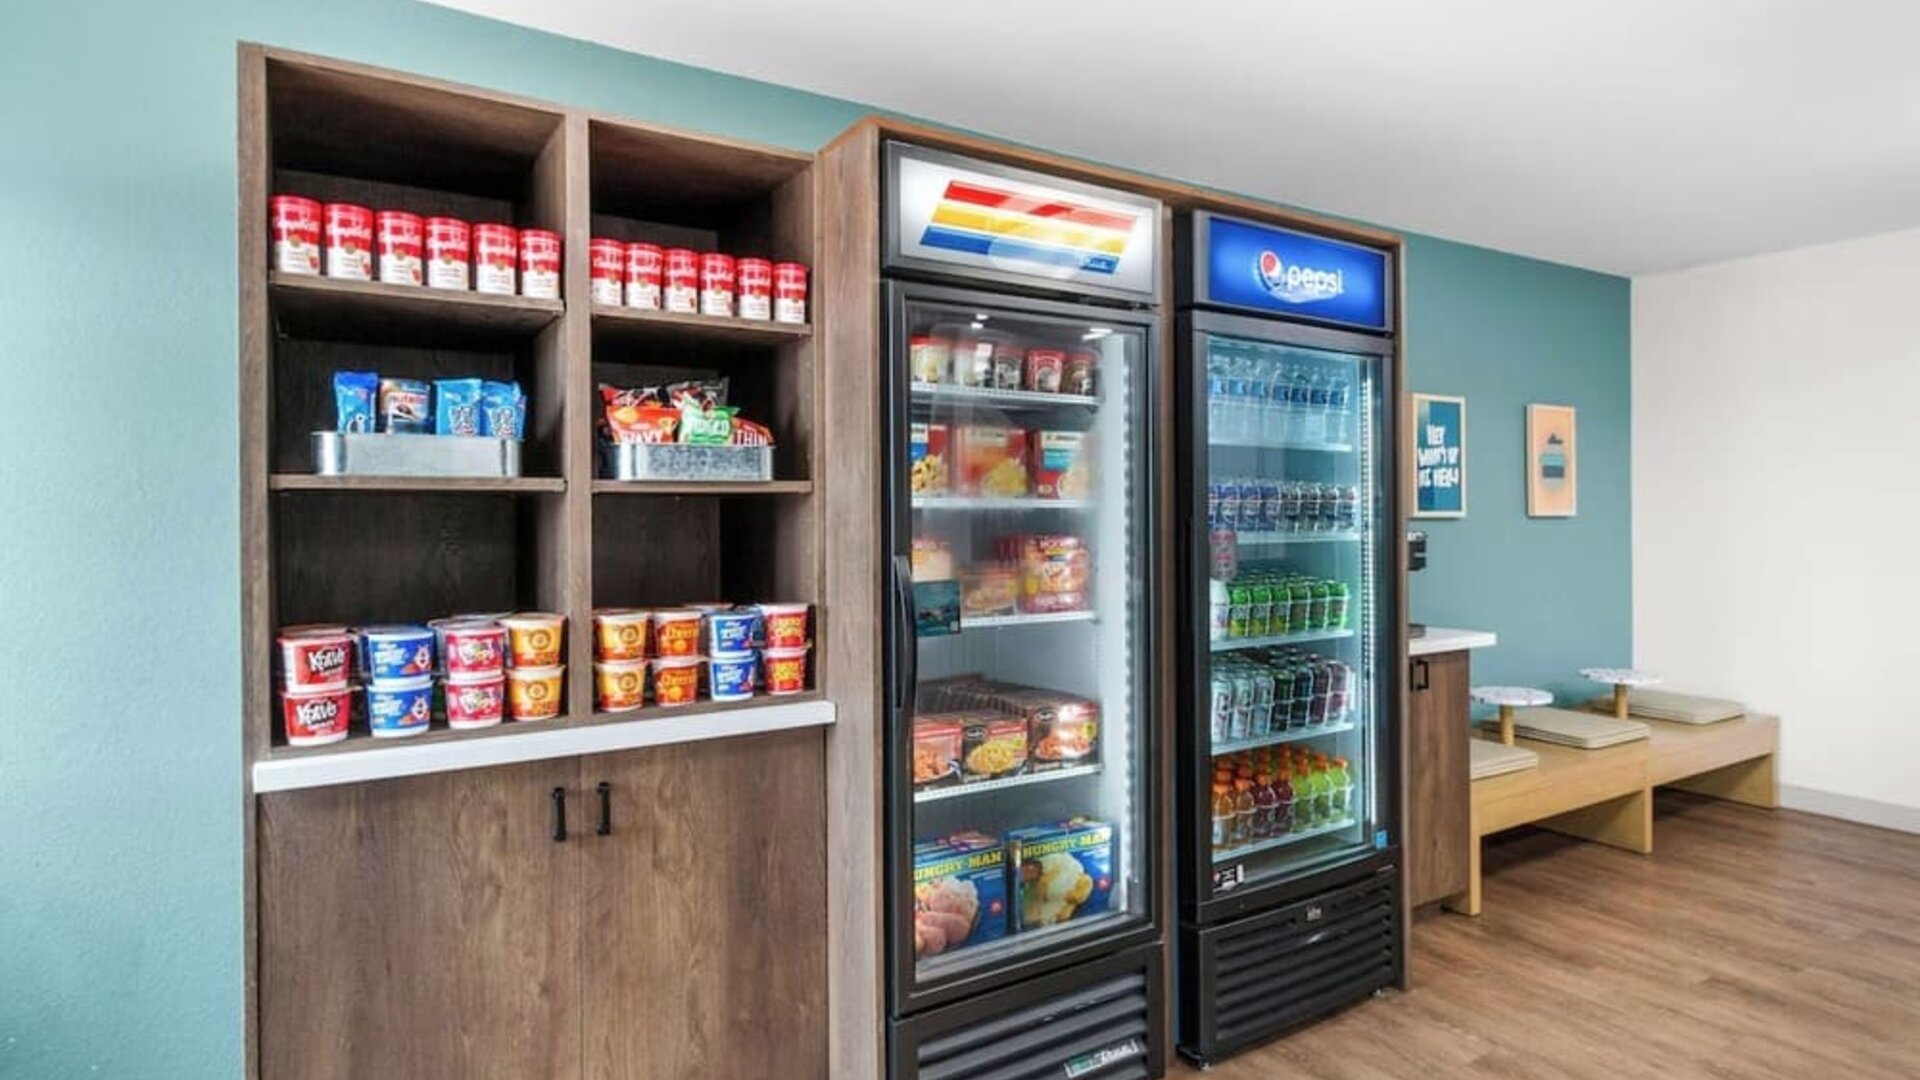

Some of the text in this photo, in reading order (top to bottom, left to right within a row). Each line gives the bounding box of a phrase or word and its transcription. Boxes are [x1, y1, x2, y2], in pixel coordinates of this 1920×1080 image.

[1287, 264, 1344, 293] pepsi
[1426, 424, 1445, 446] HEY
[308, 647, 345, 672] Krave
[296, 699, 338, 725] Krave
[914, 858, 964, 881] UNGRY
